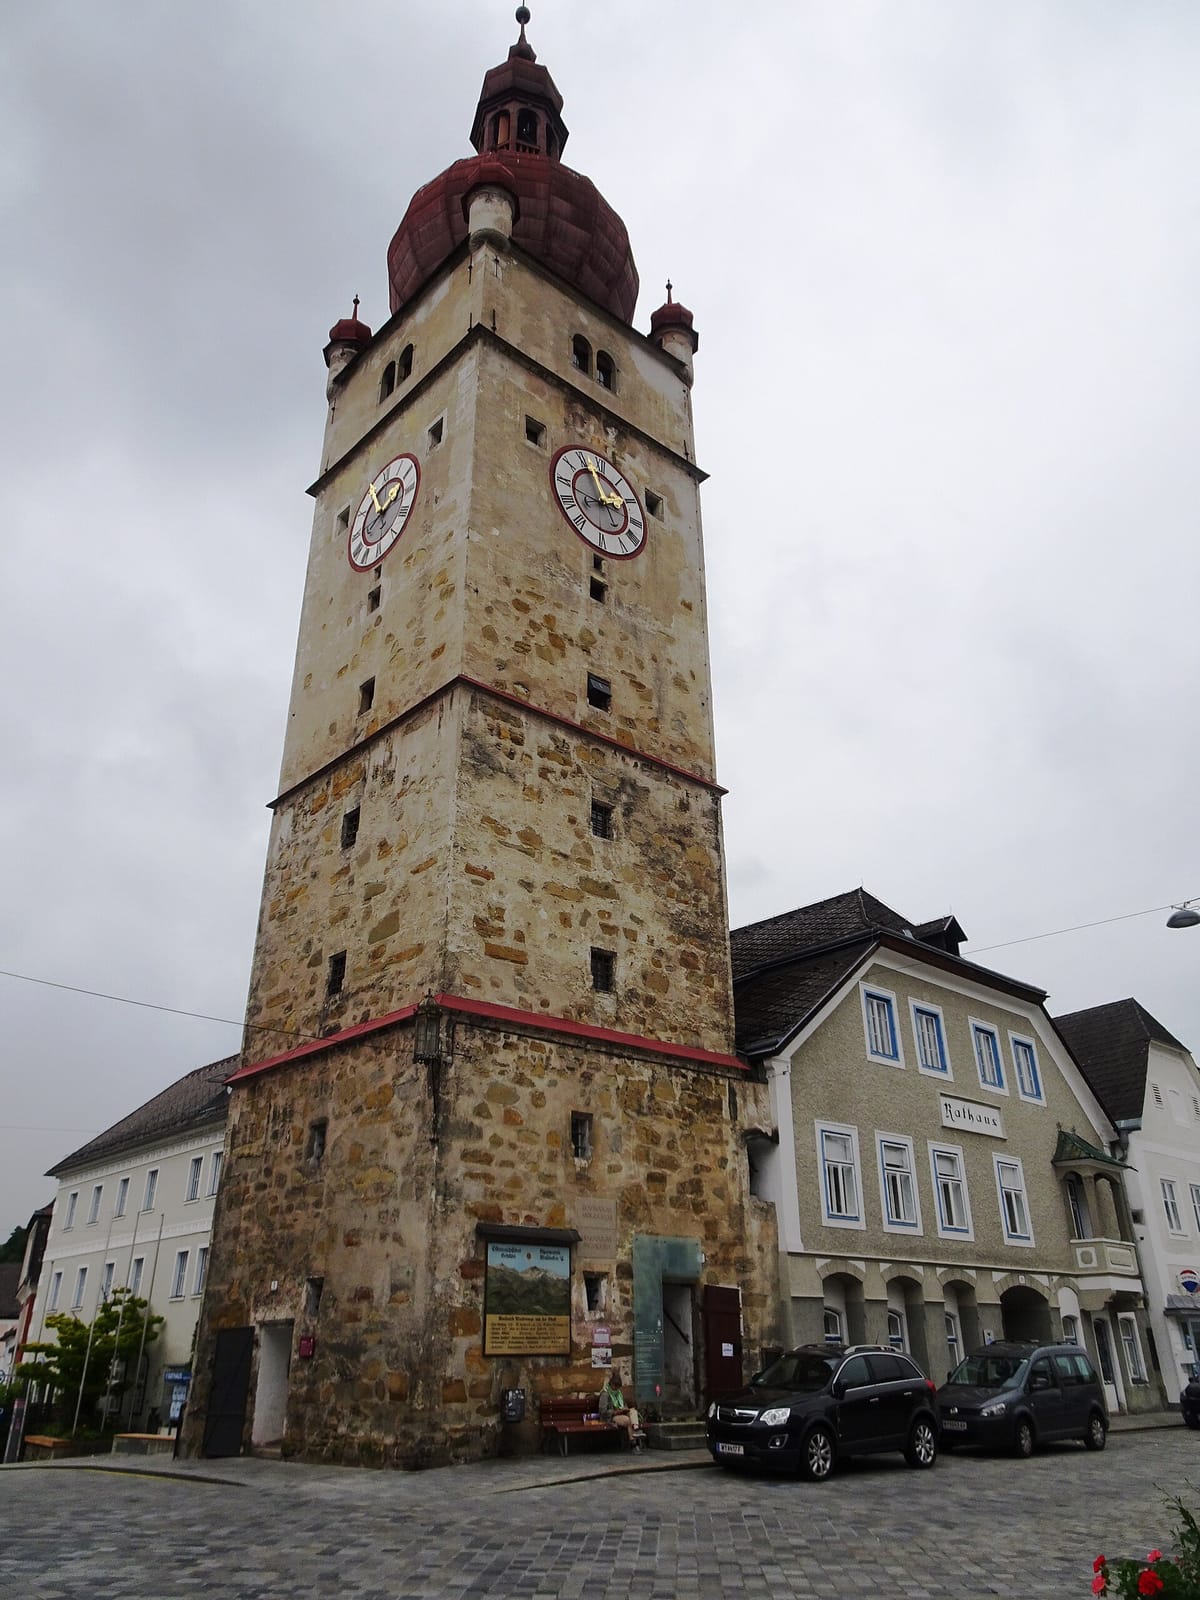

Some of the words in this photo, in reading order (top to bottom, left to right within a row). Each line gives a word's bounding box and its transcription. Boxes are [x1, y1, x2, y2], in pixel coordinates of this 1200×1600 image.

[562, 455, 576, 473] X
[594, 456, 606, 475] XII
[615, 478, 623, 486] I
[617, 536, 629, 553] V
[944, 1102, 998, 1127] Rathaus
